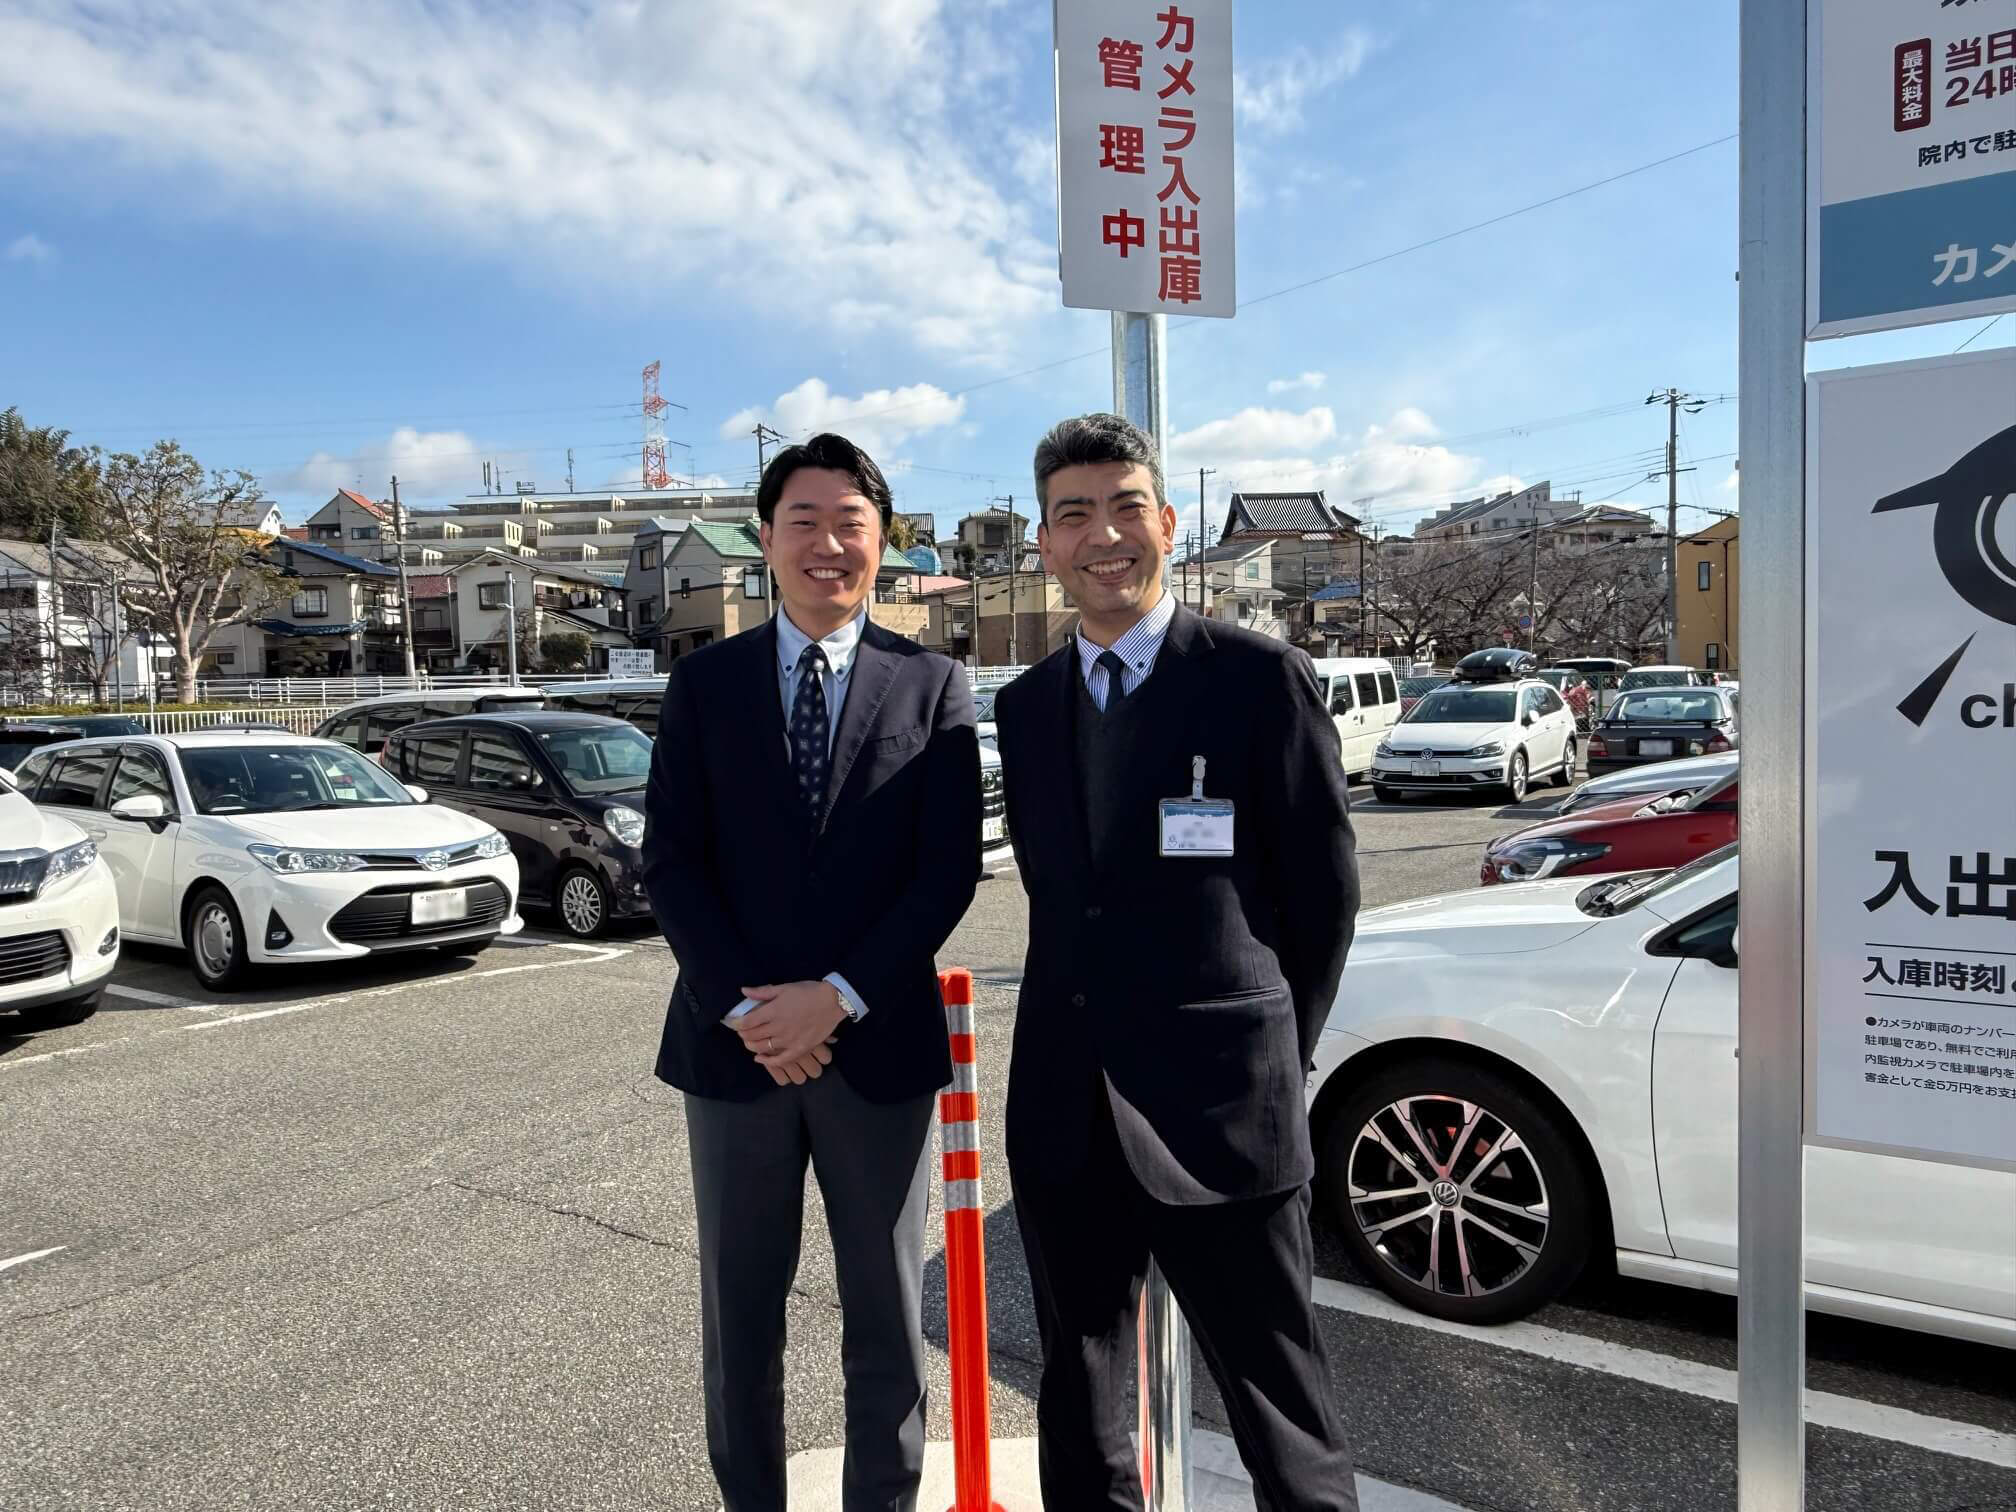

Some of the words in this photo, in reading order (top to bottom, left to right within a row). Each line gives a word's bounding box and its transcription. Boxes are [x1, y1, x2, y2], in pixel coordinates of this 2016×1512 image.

[1901, 49, 1924, 122] 最大料金
[1945, 28, 2016, 73] 当日
[1097, 37, 1146, 258] 管理中
[1156, 5, 1202, 304] カメラ入出庫
[1862, 956, 2016, 994] 入庫時刻
